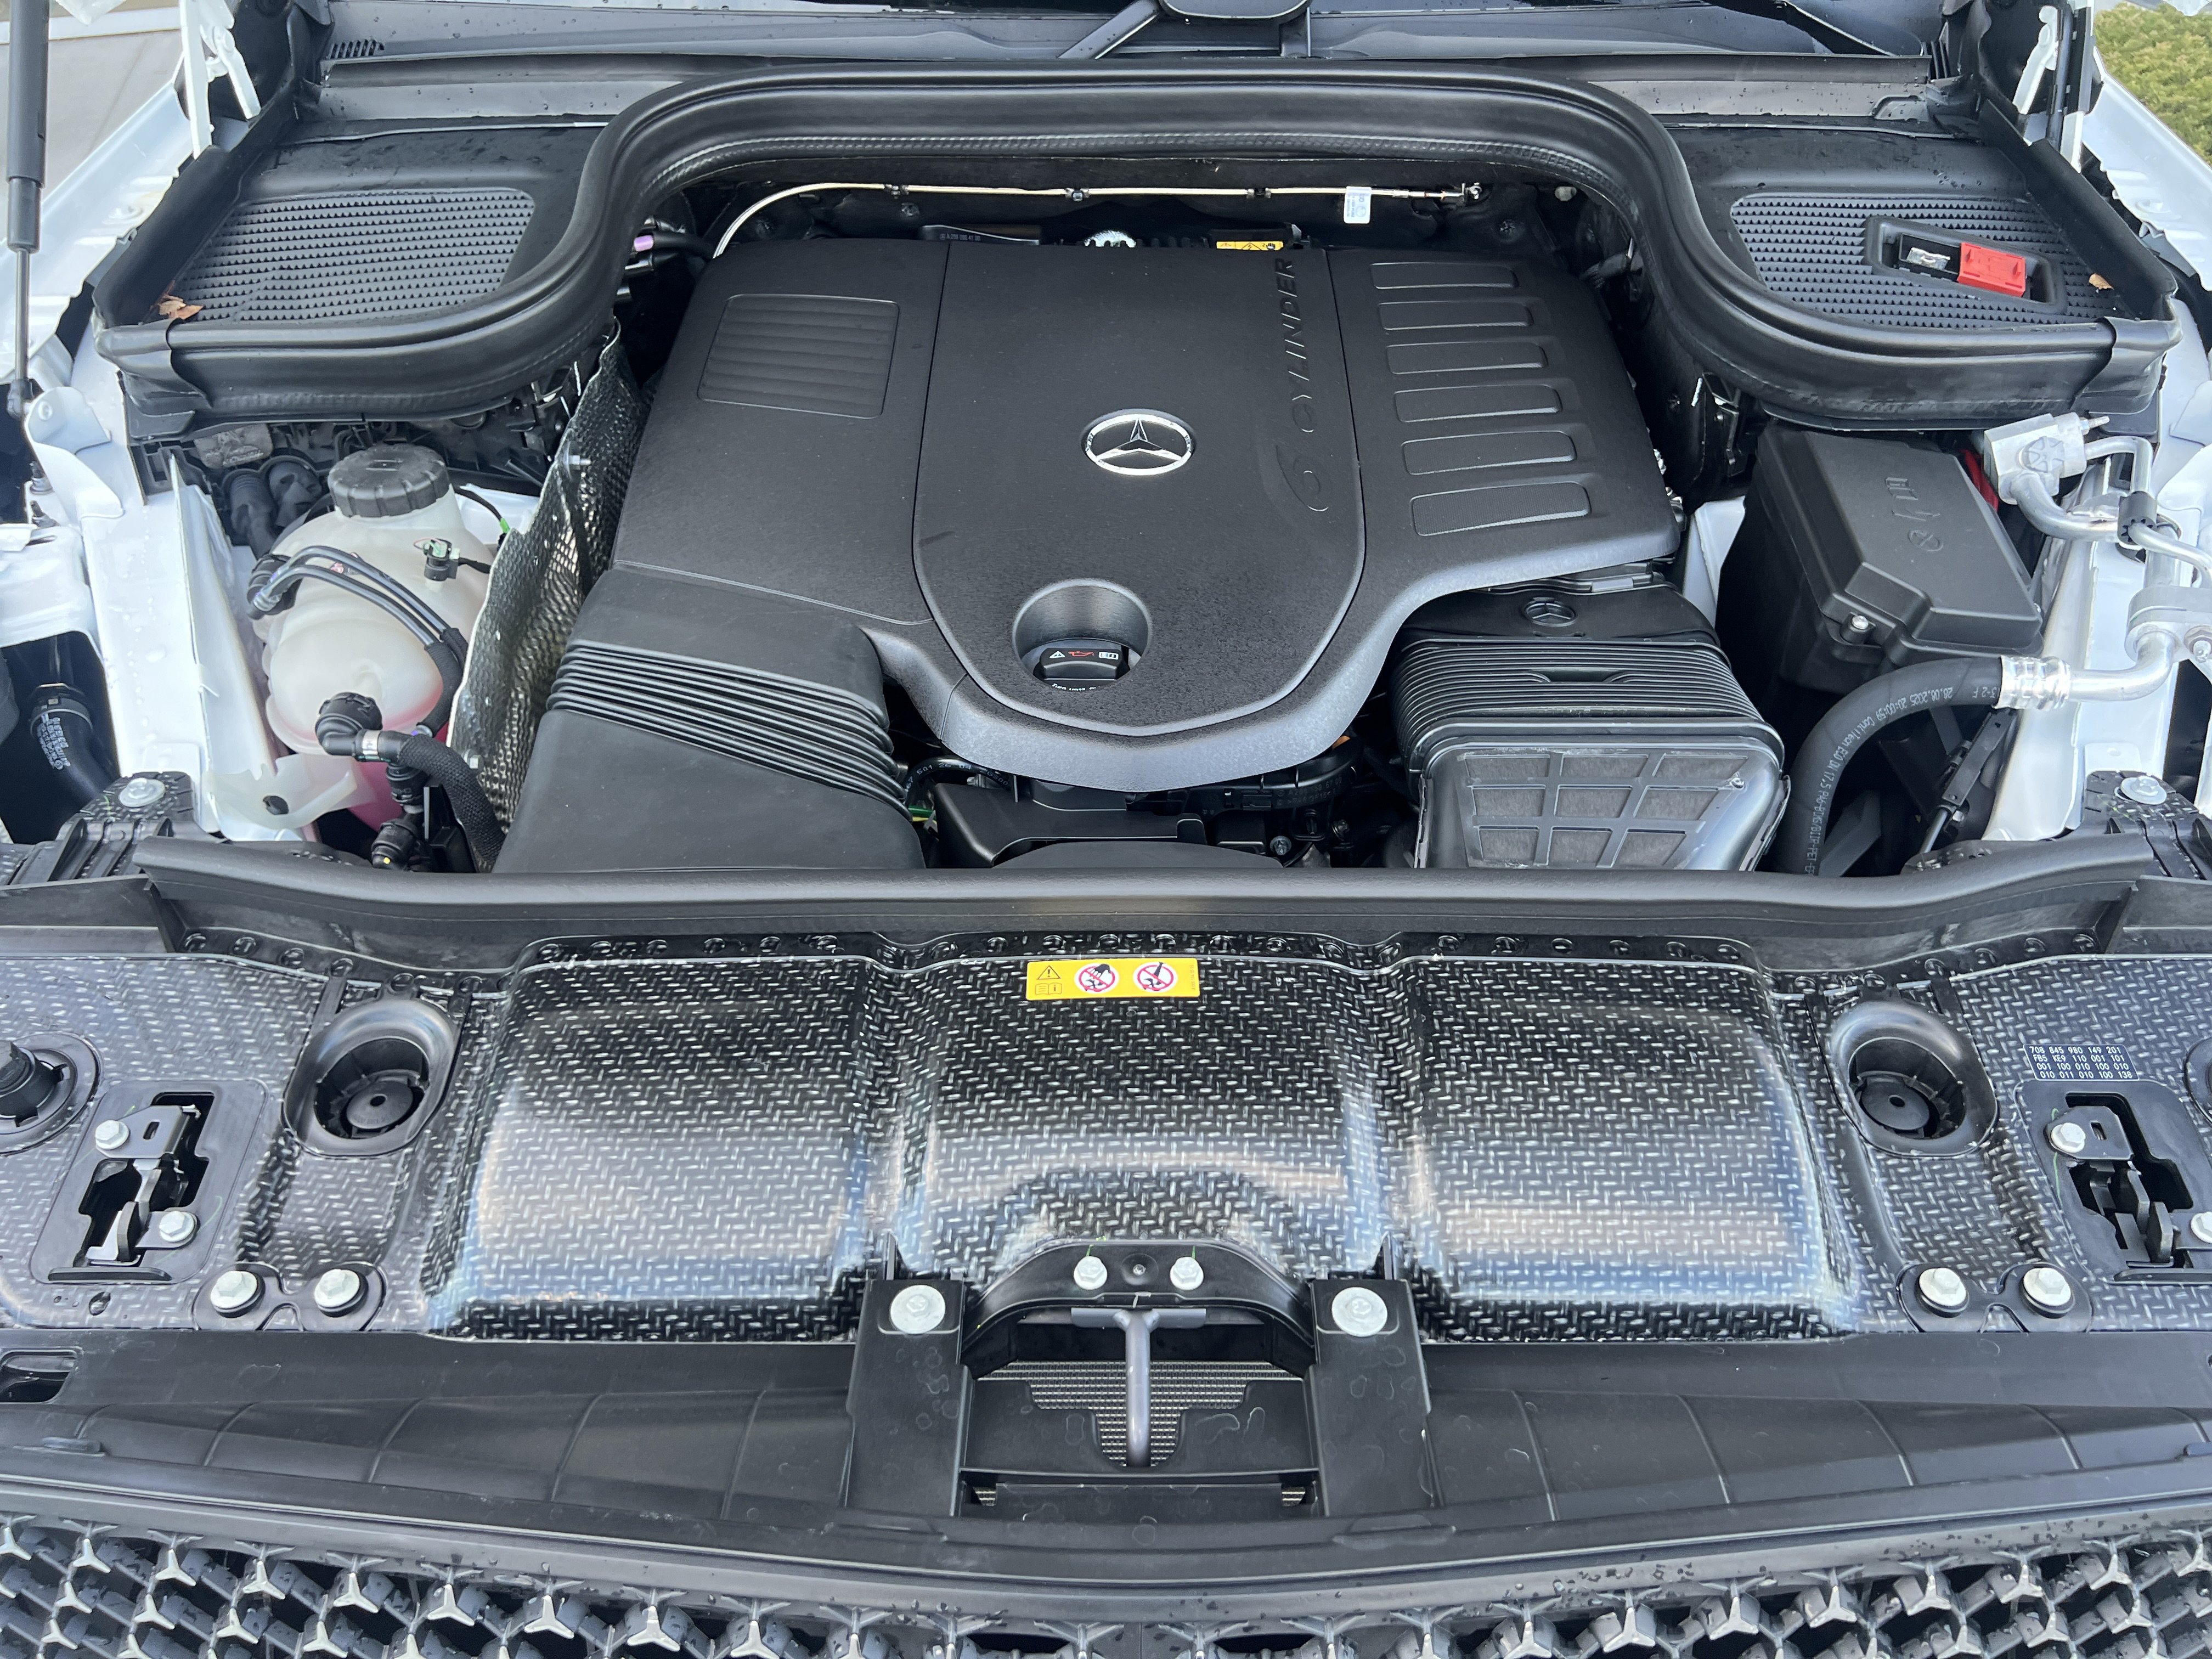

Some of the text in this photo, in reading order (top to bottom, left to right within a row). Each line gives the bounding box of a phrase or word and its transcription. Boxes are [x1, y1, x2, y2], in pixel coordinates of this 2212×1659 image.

[1275, 258, 1316, 433] CYLINDER
[1910, 687, 1953, 706] 28.08.2025
[1875, 697, 1907, 721] 20:00:59
[917, 764, 933, 776] 501
